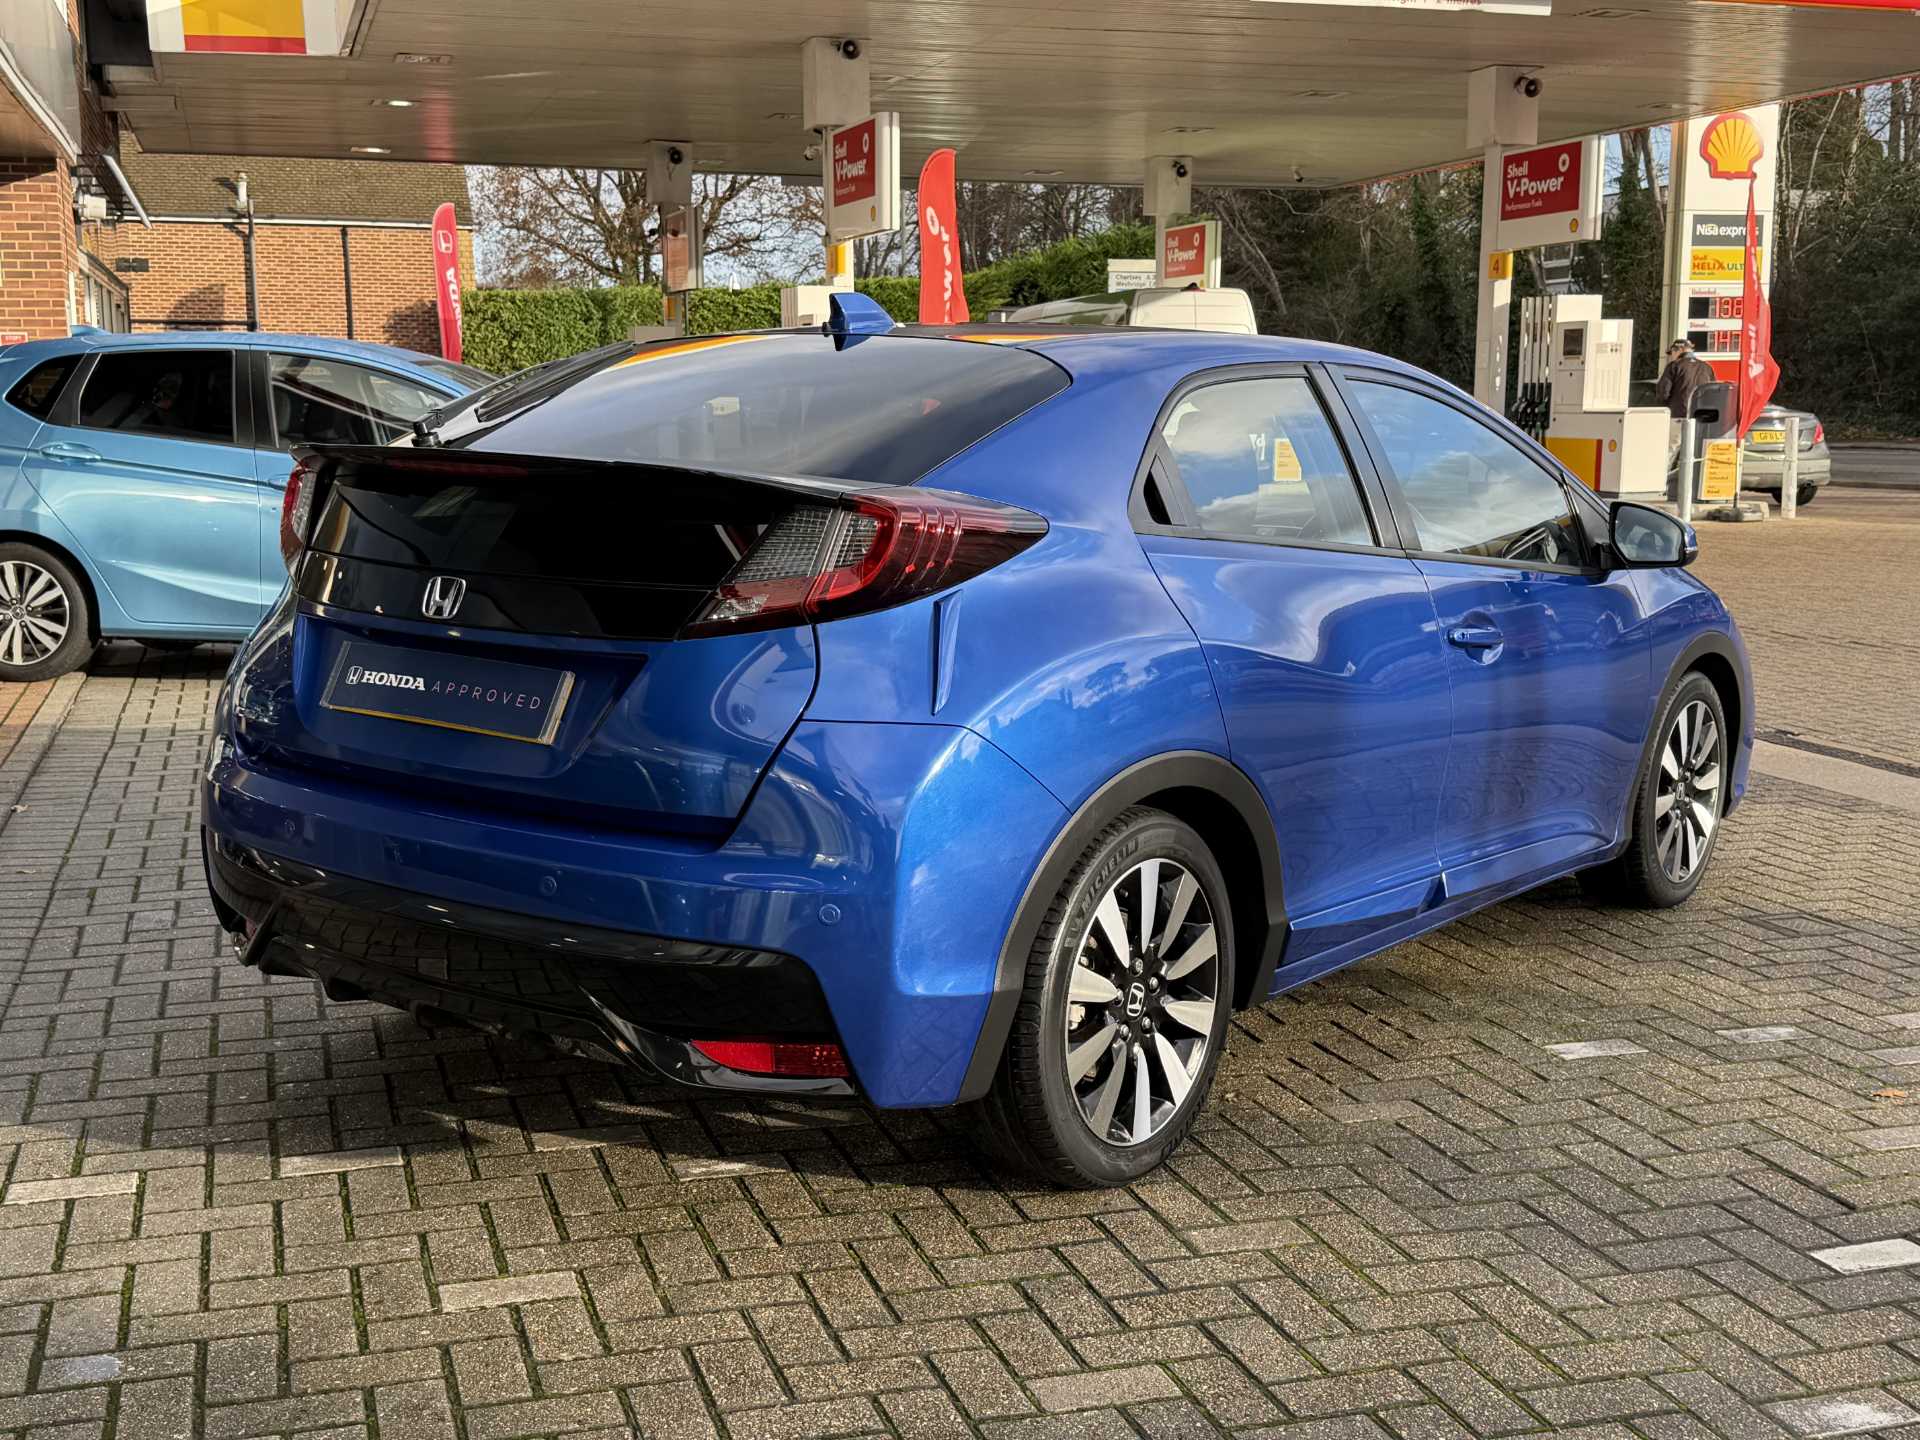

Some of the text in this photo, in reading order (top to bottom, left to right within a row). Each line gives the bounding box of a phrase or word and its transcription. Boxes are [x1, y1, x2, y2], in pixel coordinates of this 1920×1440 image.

[835, 158, 867, 182] V-Power
[1507, 160, 1529, 178] Shell
[1507, 175, 1565, 199] V-Power
[1696, 223, 1760, 238] Nisa exprs
[1167, 249, 1198, 263] V-Power
[1493, 259, 1500, 274] 4
[1692, 260, 1726, 271] HELIX
[363, 670, 542, 710] HONDA APPROVED
[1079, 838, 1140, 915] MICHELIN
